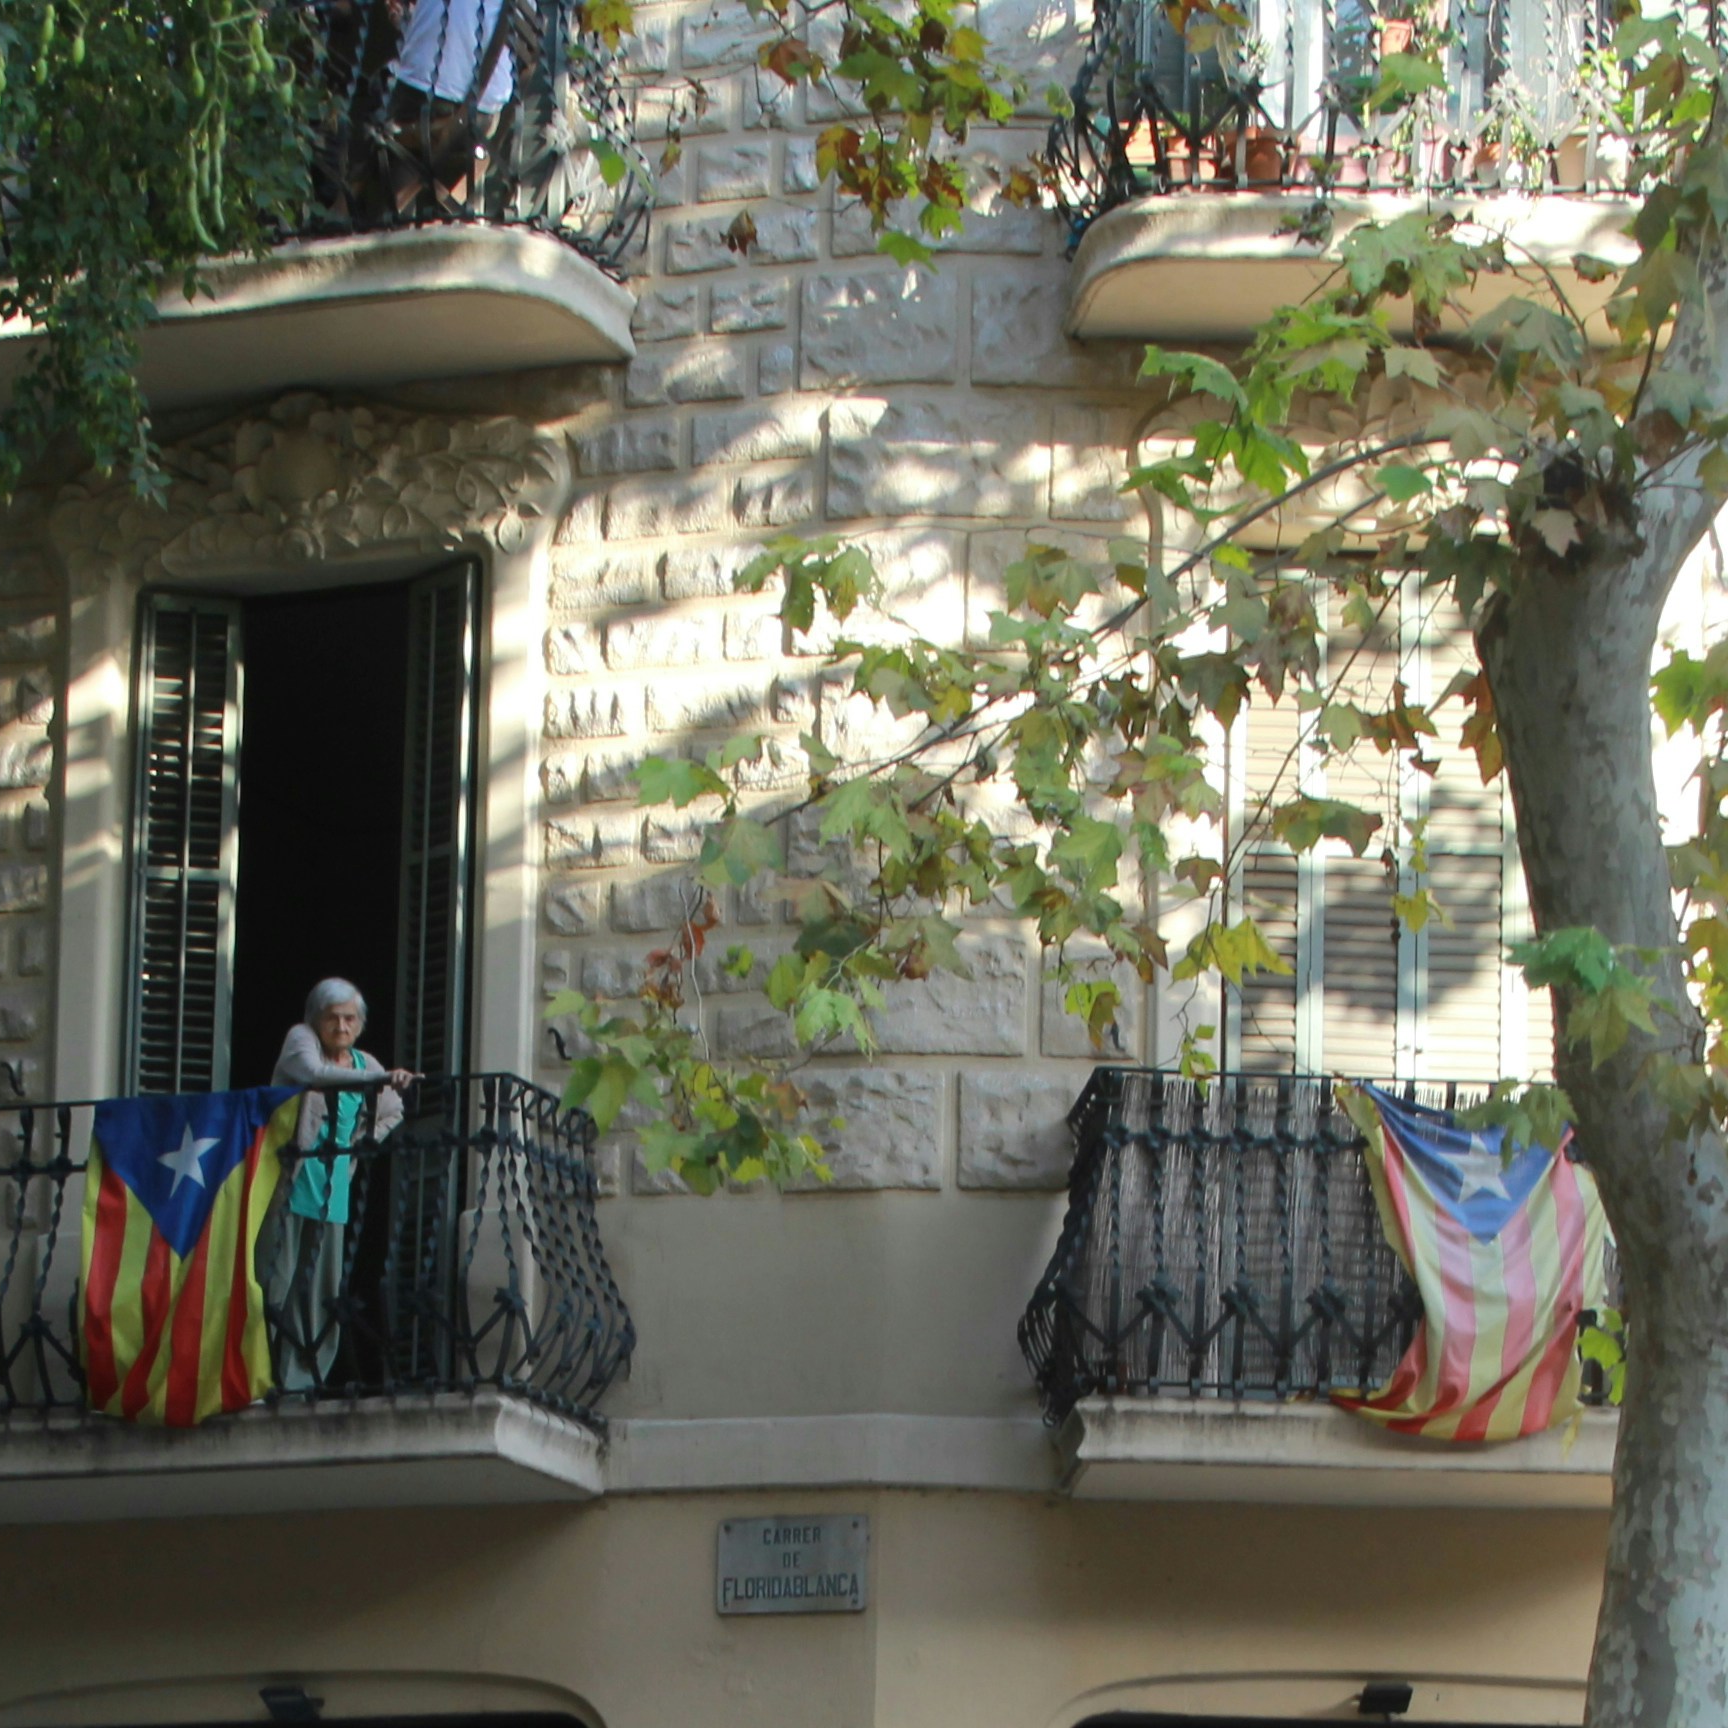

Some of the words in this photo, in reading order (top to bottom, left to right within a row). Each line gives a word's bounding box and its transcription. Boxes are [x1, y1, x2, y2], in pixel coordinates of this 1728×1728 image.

[762, 1526, 822, 1546] CARRER
[782, 1551, 801, 1569] DE
[722, 1572, 859, 1604] FLORIDABLANCA
